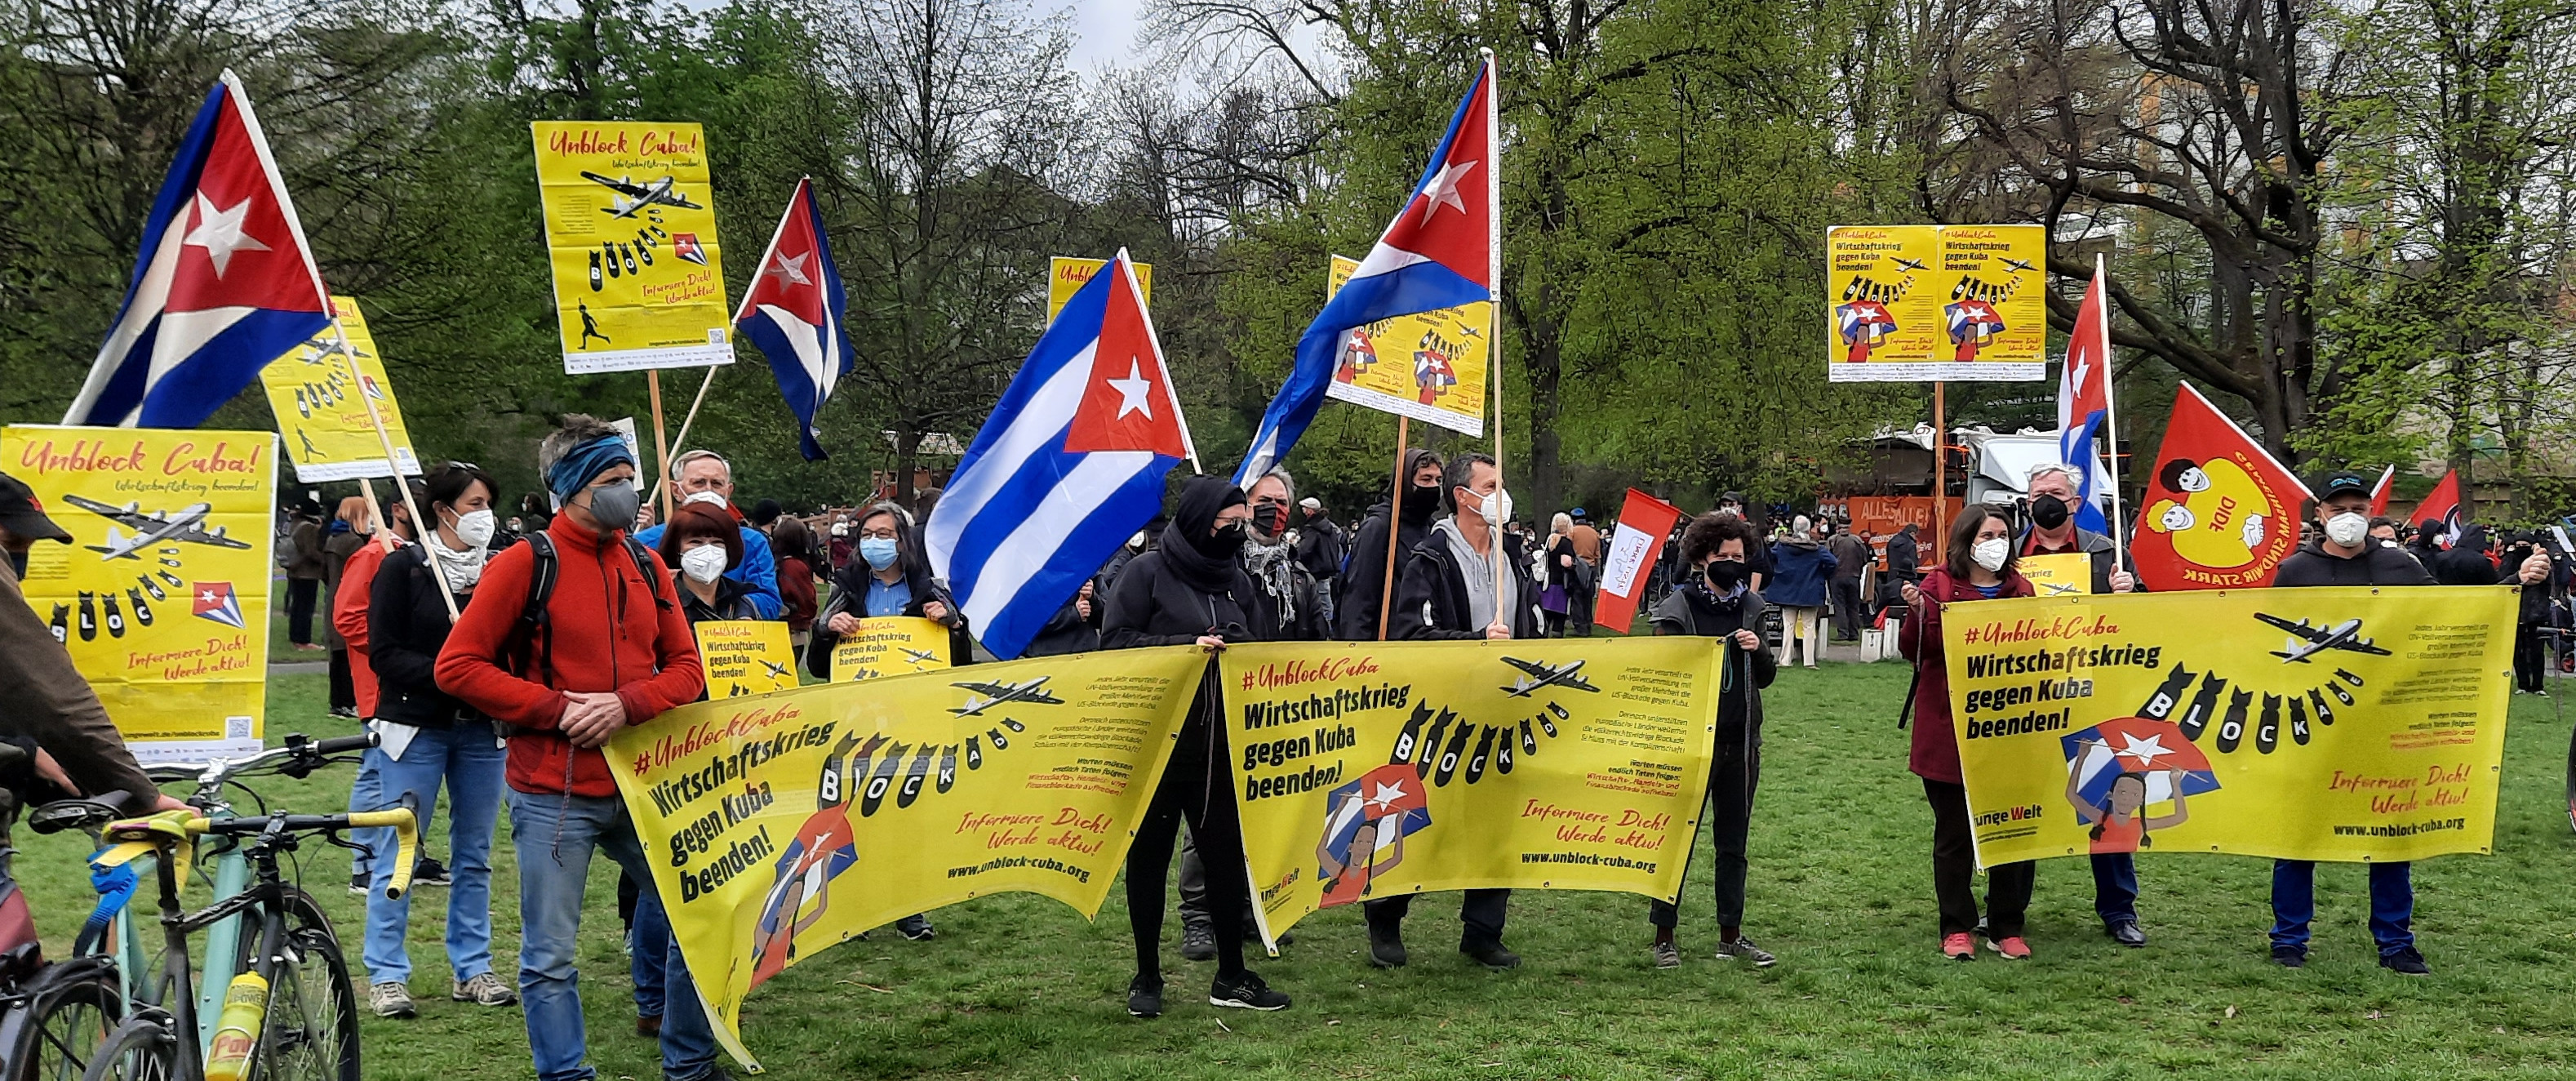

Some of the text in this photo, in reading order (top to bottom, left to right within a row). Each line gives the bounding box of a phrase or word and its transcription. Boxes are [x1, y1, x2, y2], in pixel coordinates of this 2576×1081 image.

[550, 130, 697, 156] Unblock Cuba!
[1060, 265, 1094, 284] Unbl
[20, 440, 147, 476] Unblock
[162, 442, 261, 476] Cuba!
[205, 634, 247, 656] Dich!
[838, 632, 911, 645] Wirtschaftskrieg
[1965, 614, 2121, 647] #UnblockCuba
[707, 640, 766, 653] Wirtschaftskrieg
[710, 655, 750, 666] gegen Kuba
[839, 644, 887, 656] gegen Kuba
[839, 655, 878, 665] beenden!
[1967, 643, 2161, 678] Wirtschaftskrieg
[164, 658, 208, 680] Werde
[712, 668, 746, 678] beenden!
[1241, 656, 1380, 692] #UnblockCuba
[1244, 683, 1411, 730] Wirtschaftskrieg
[1965, 678, 2093, 713] gegen Kuba
[2147, 677, 2361, 742] BLOCKADE
[1966, 707, 2070, 740] beenden!
[633, 702, 801, 777] #UnblockCuba
[1243, 723, 1356, 770] gegen Kuba
[1396, 710, 1566, 772] BLOCKADE
[647, 720, 838, 818] Wirtschaftskrieg
[1246, 759, 1343, 802] beenden!
[2329, 763, 2472, 793] Informiere Dich!
[1521, 799, 1672, 831] Informiere Dich!
[2371, 787, 2468, 814] Werde aktiv!
[669, 781, 774, 868] gegen Kuba
[955, 807, 1113, 834] Informiere Dich!
[1974, 804, 2042, 827] unge Welt
[2334, 817, 2465, 838] www.unblock-cuba.org
[987, 827, 1104, 856] Werde aktiv!
[1557, 825, 1666, 850] Werde aktiv!
[680, 825, 775, 903] beenden!
[948, 855, 1090, 884] www.unblock-cuba.org
[1521, 852, 1656, 874] www.unblock-cuba.org
